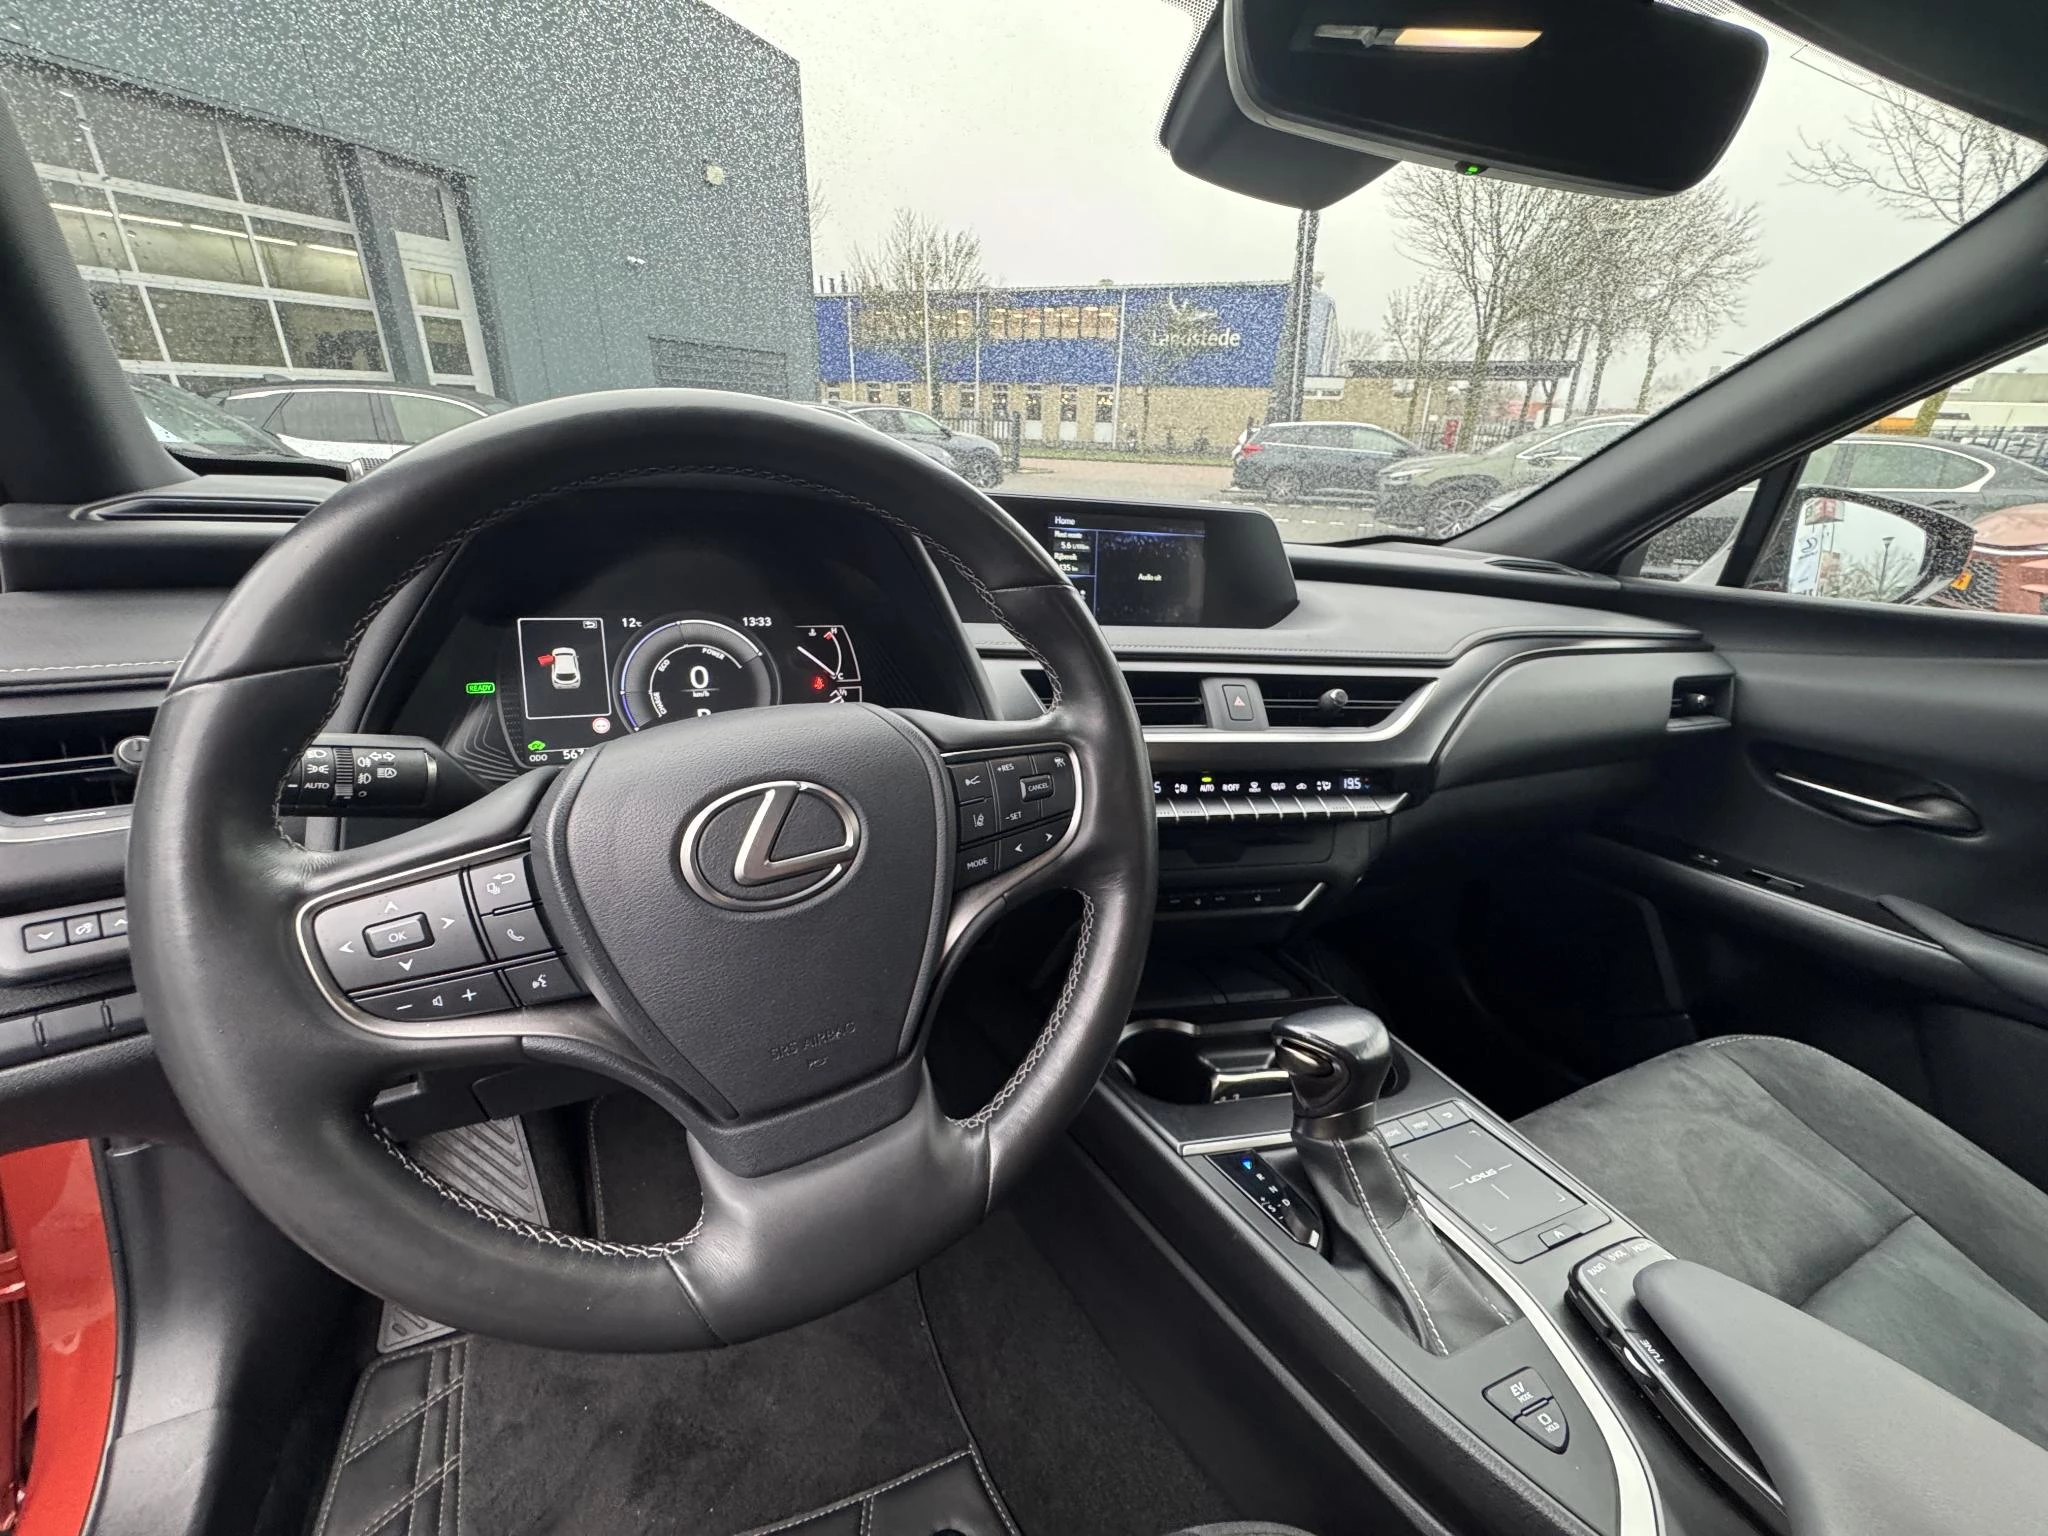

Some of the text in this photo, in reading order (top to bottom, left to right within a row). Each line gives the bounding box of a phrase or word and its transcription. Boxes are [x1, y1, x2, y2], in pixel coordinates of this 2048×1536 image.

[1054, 516, 1076, 525] Home
[742, 616, 772, 627] 13:33
[701, 647, 726, 661] POWER
[657, 658, 671, 673] ECO
[689, 665, 709, 689] 0
[468, 684, 492, 692] READY
[528, 754, 548, 762] ODO
[304, 782, 330, 790] AUTO
[1027, 782, 1049, 792] CANCEL
[1199, 783, 1215, 792] AUTO
[966, 857, 989, 870] MODE
[388, 930, 408, 943] OK
[1465, 1168, 1498, 1184] LEXUS
[1639, 1339, 1665, 1365] TUNE
[1510, 1381, 1525, 1397] EV
